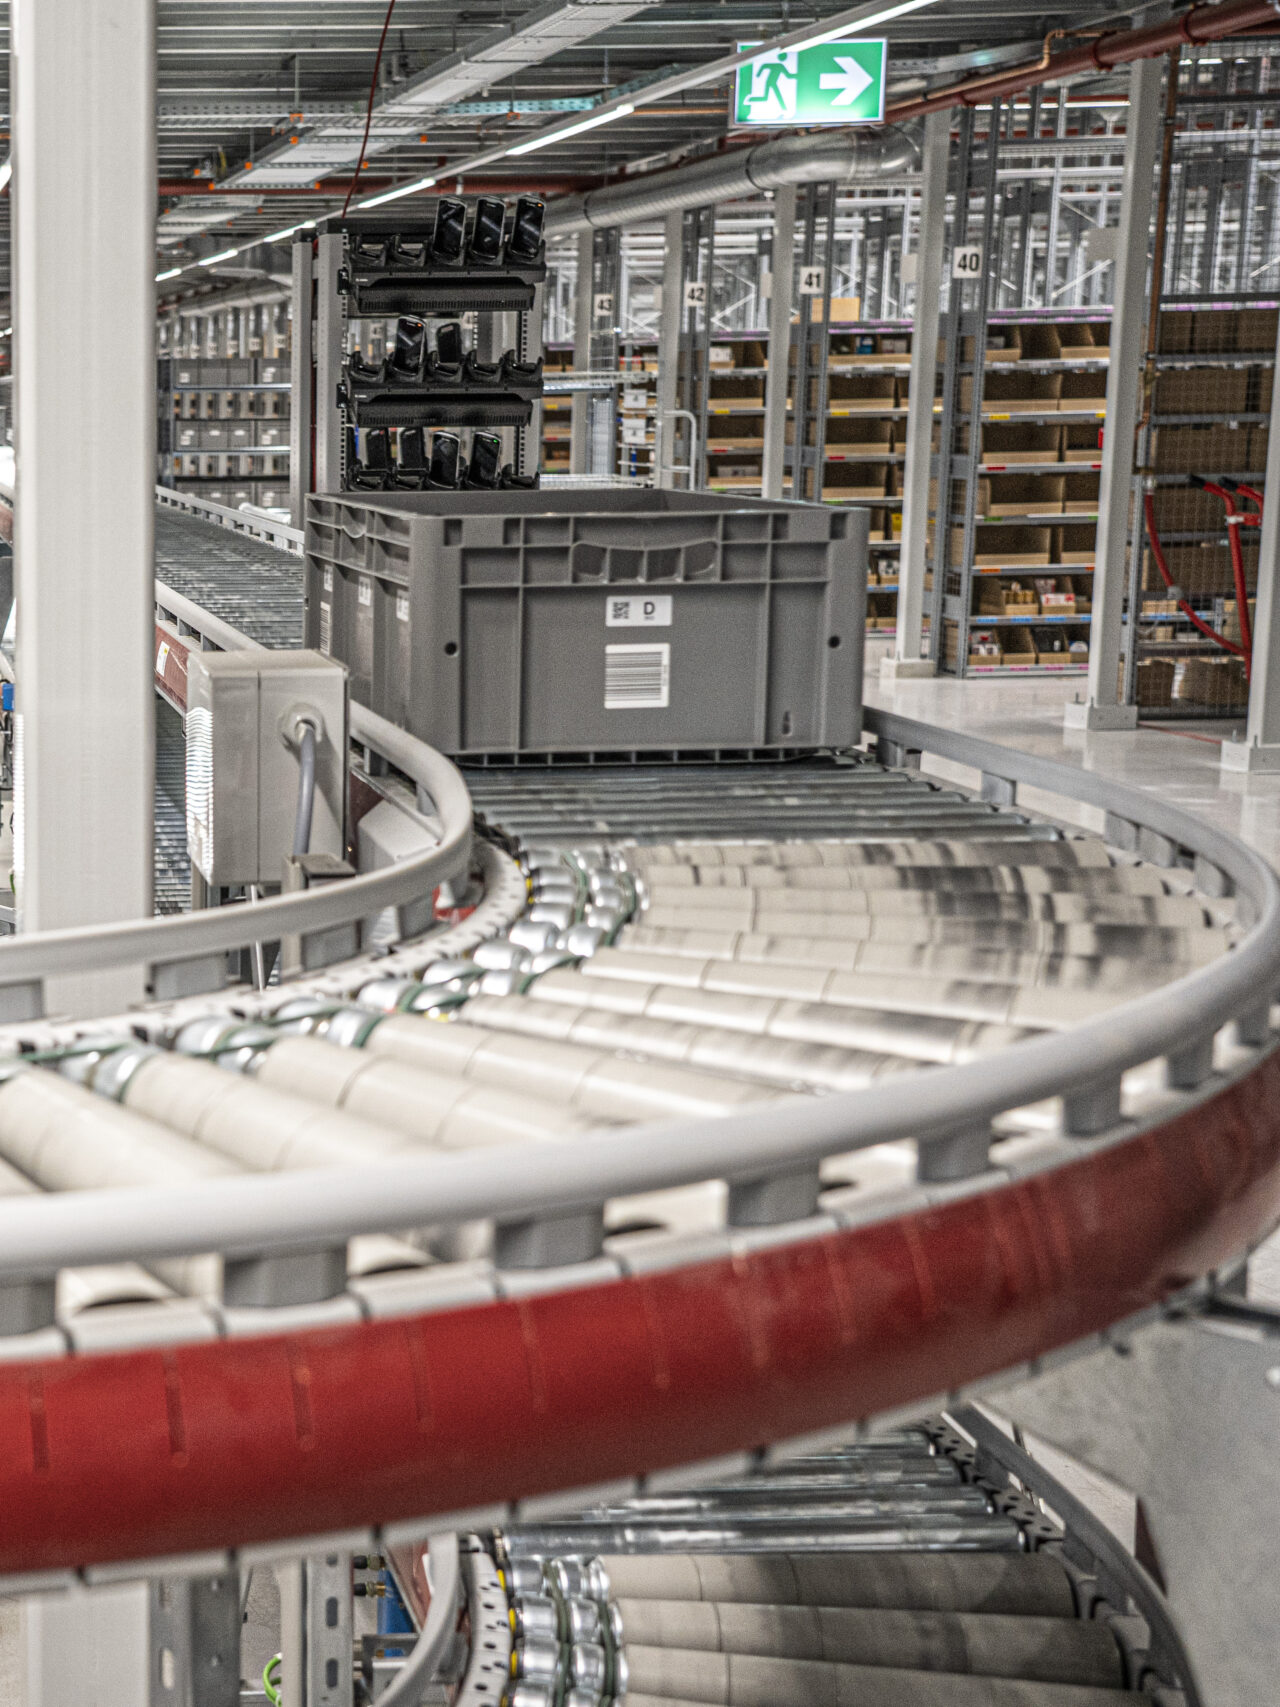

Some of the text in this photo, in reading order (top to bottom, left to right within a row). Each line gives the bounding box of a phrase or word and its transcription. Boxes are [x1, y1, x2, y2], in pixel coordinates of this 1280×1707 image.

[957, 253, 980, 272] 40
[804, 273, 821, 288] 41
[687, 288, 705, 302] 42
[643, 601, 655, 616] D
